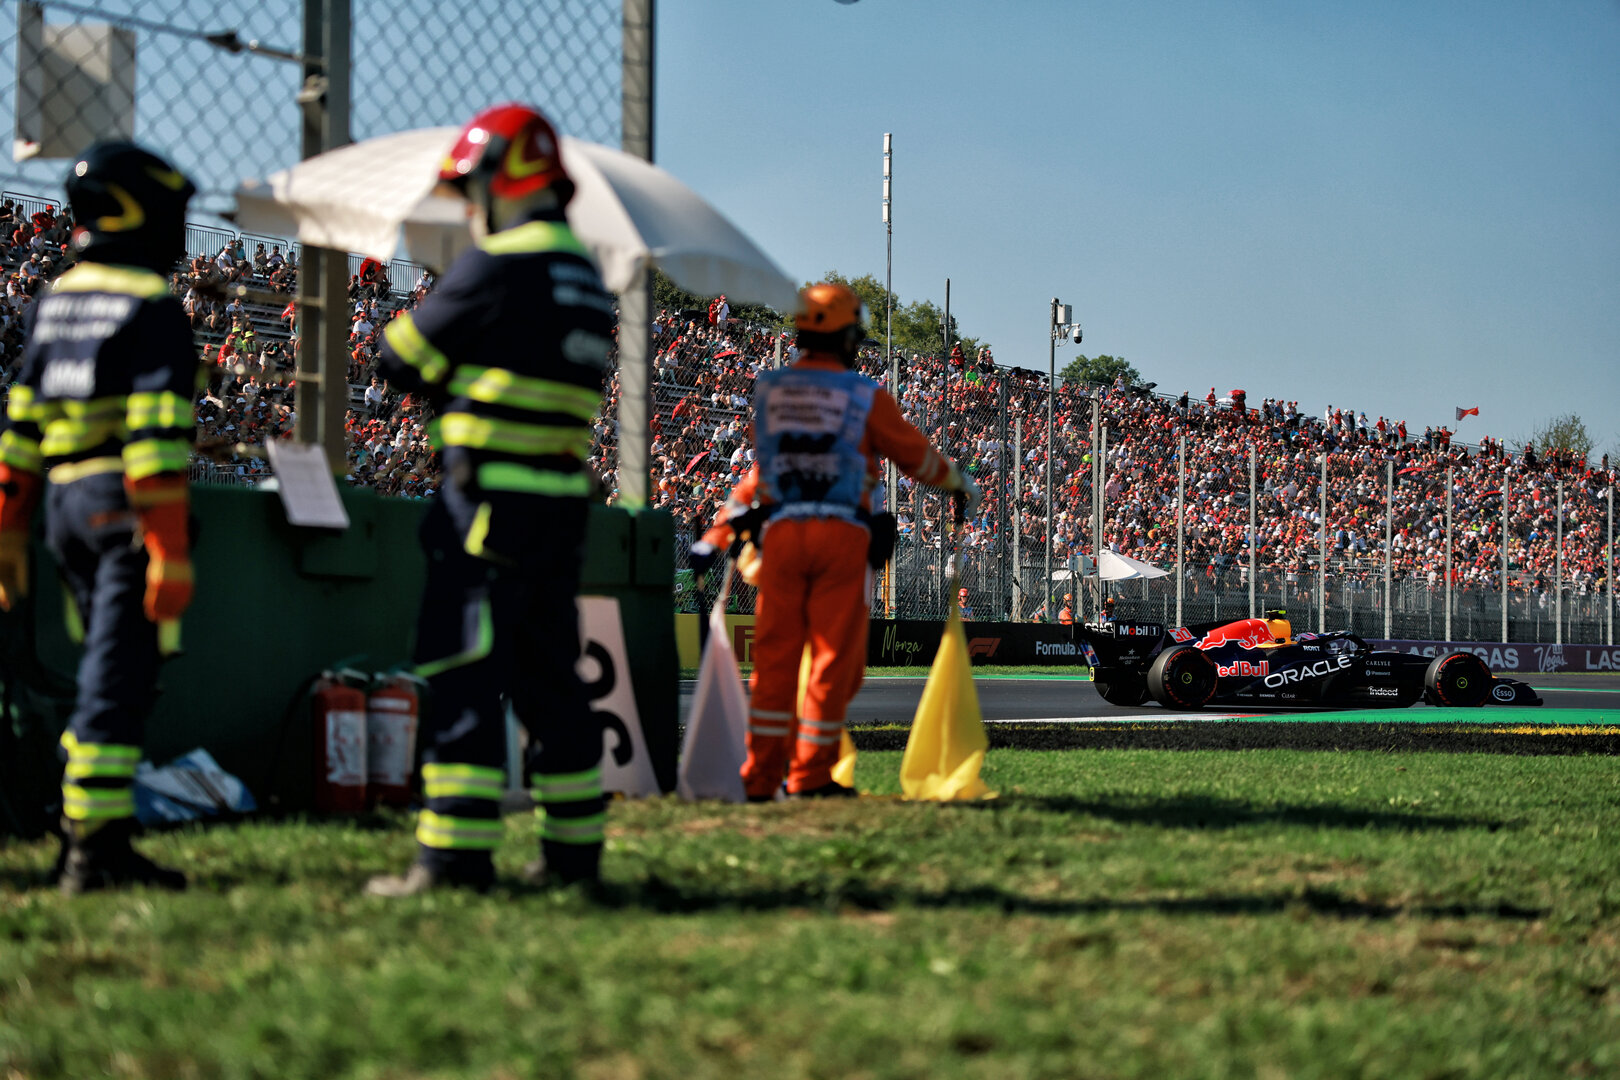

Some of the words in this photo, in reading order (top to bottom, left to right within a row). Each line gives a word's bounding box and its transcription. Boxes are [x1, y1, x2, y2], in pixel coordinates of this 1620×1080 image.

[1119, 625, 1149, 636] Mobil
[1169, 627, 1193, 642] 30
[882, 624, 923, 666] Monza
[1035, 640, 1076, 656] Formula
[1534, 645, 1568, 673] Vegas
[1240, 660, 1269, 677] Bull
[1264, 656, 1352, 689] ORACLE
[1367, 685, 1398, 696] indeed
